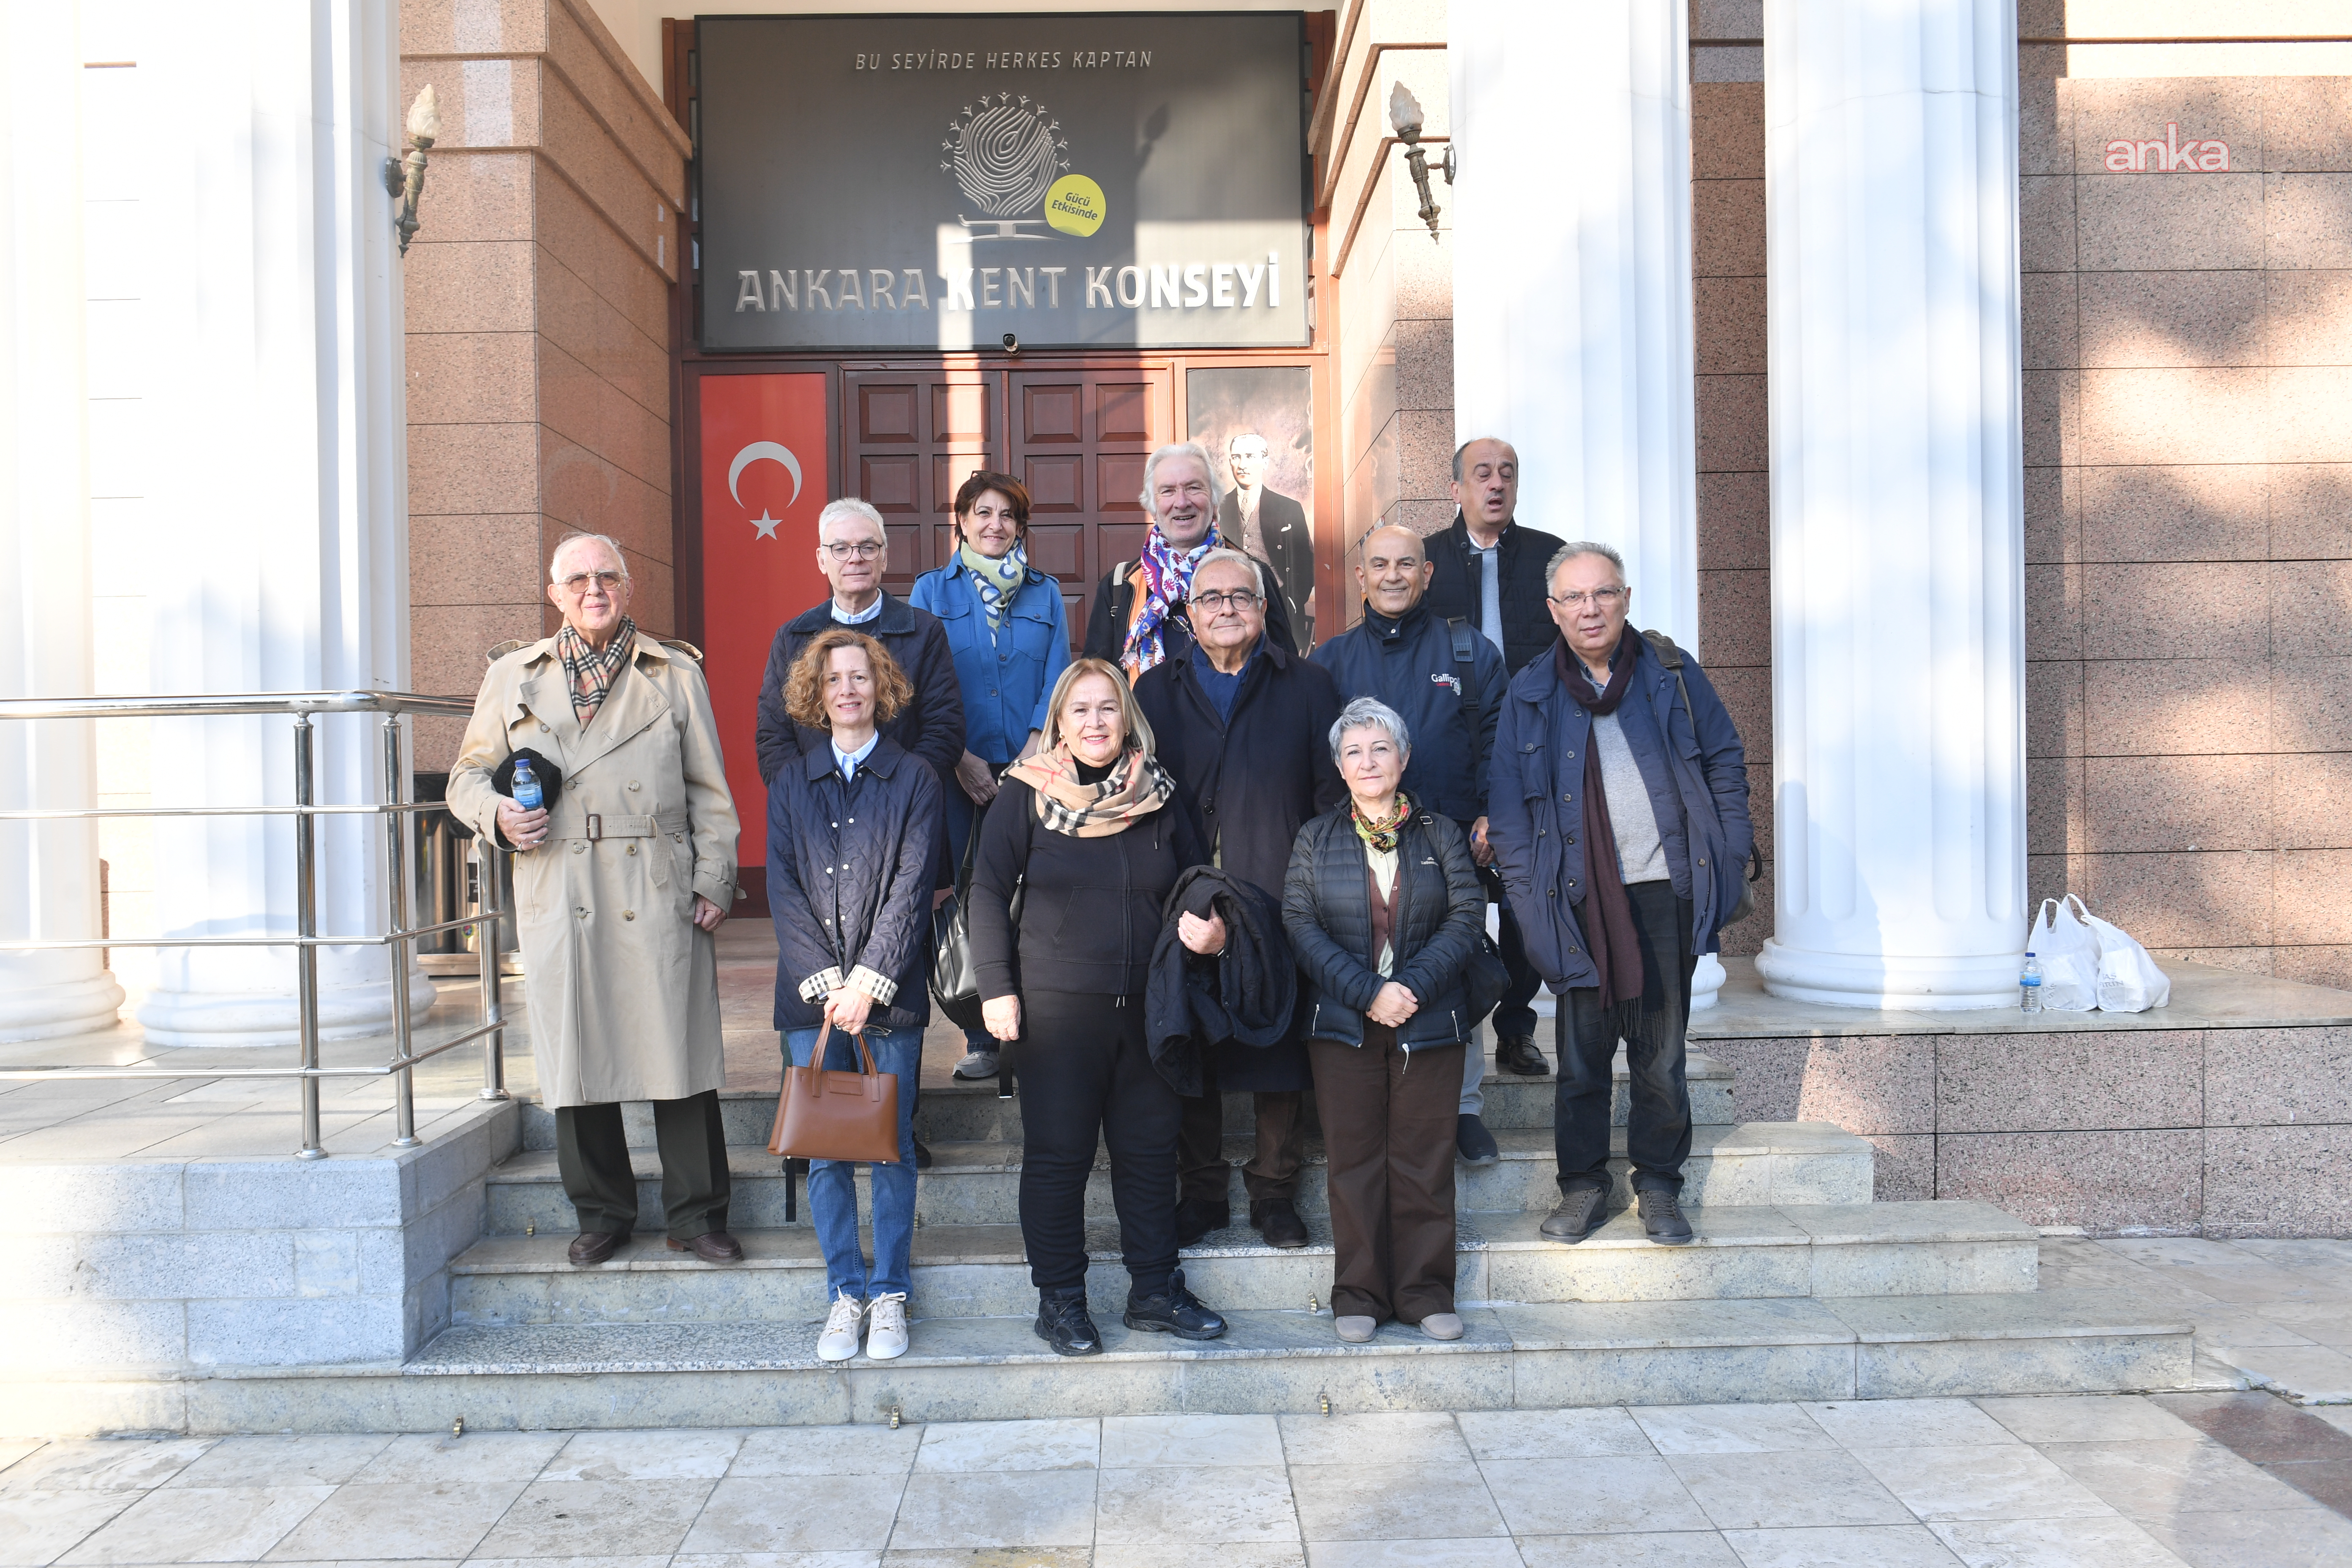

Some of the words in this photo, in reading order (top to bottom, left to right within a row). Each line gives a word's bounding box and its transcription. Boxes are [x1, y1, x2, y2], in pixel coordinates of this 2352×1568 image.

[855, 54, 880, 70] BU
[891, 49, 975, 70] SEYİRDE
[985, 52, 1061, 69] HERKES
[1072, 51, 1152, 68] KAPTAN
[1051, 199, 1098, 220] Etkisinde
[1065, 192, 1091, 207] Gücü
[735, 269, 929, 312] ANKARA
[946, 267, 1067, 310] KENT
[1085, 252, 1279, 309] KONSEYİ
